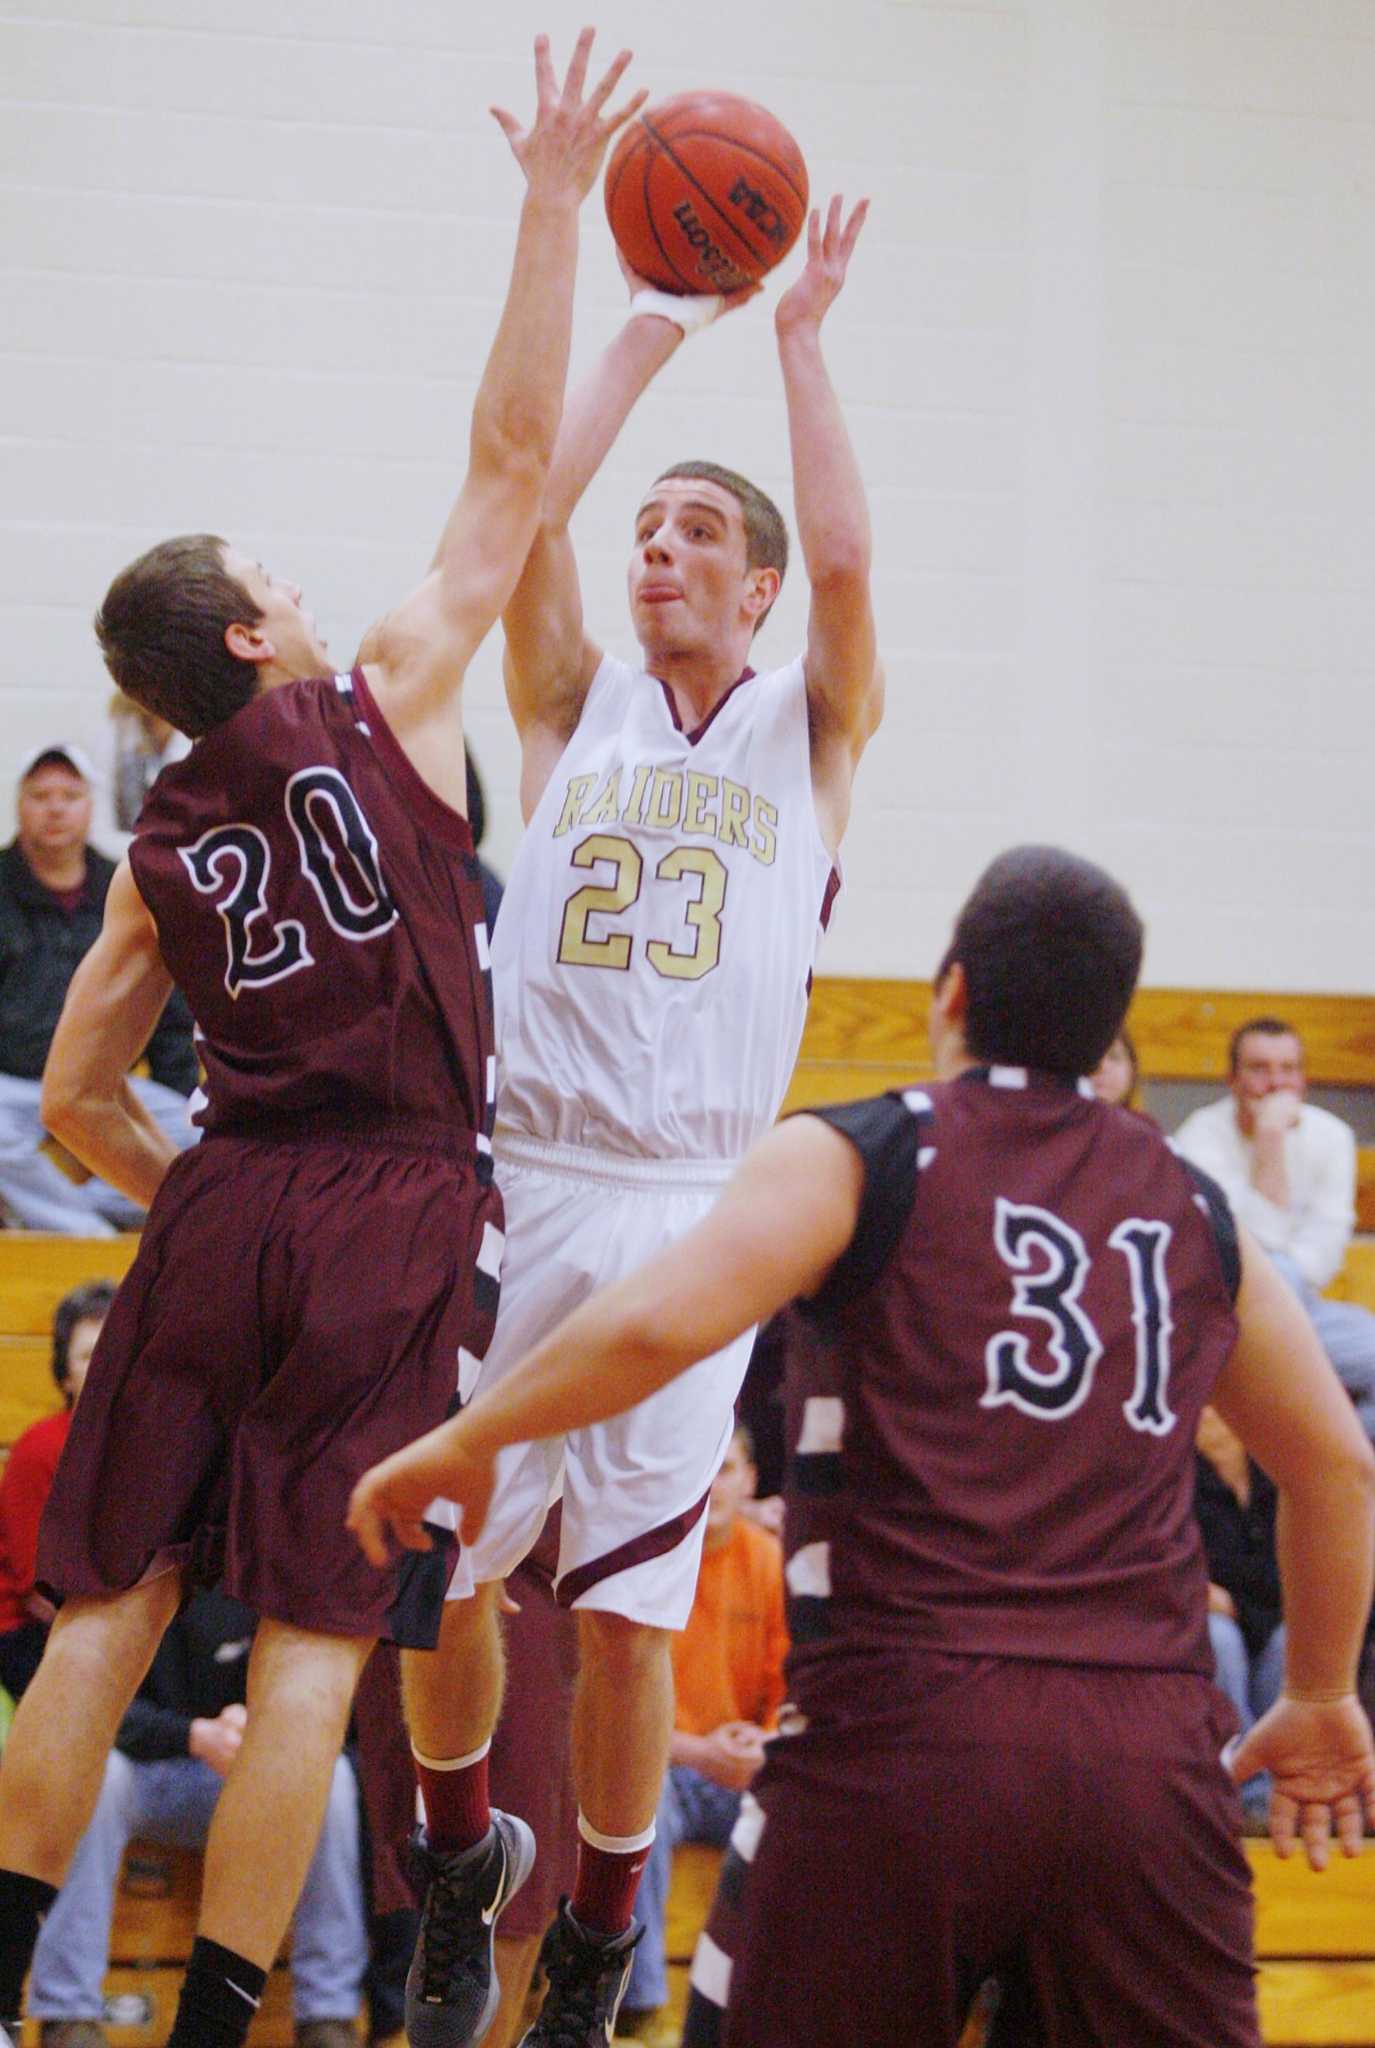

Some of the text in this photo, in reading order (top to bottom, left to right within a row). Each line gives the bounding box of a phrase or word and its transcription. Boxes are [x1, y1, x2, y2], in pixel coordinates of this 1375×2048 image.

[176, 765, 399, 1000] 20
[552, 766, 778, 867] RAIDERS
[556, 833, 729, 981] 23
[979, 1197, 1176, 1436] 31
